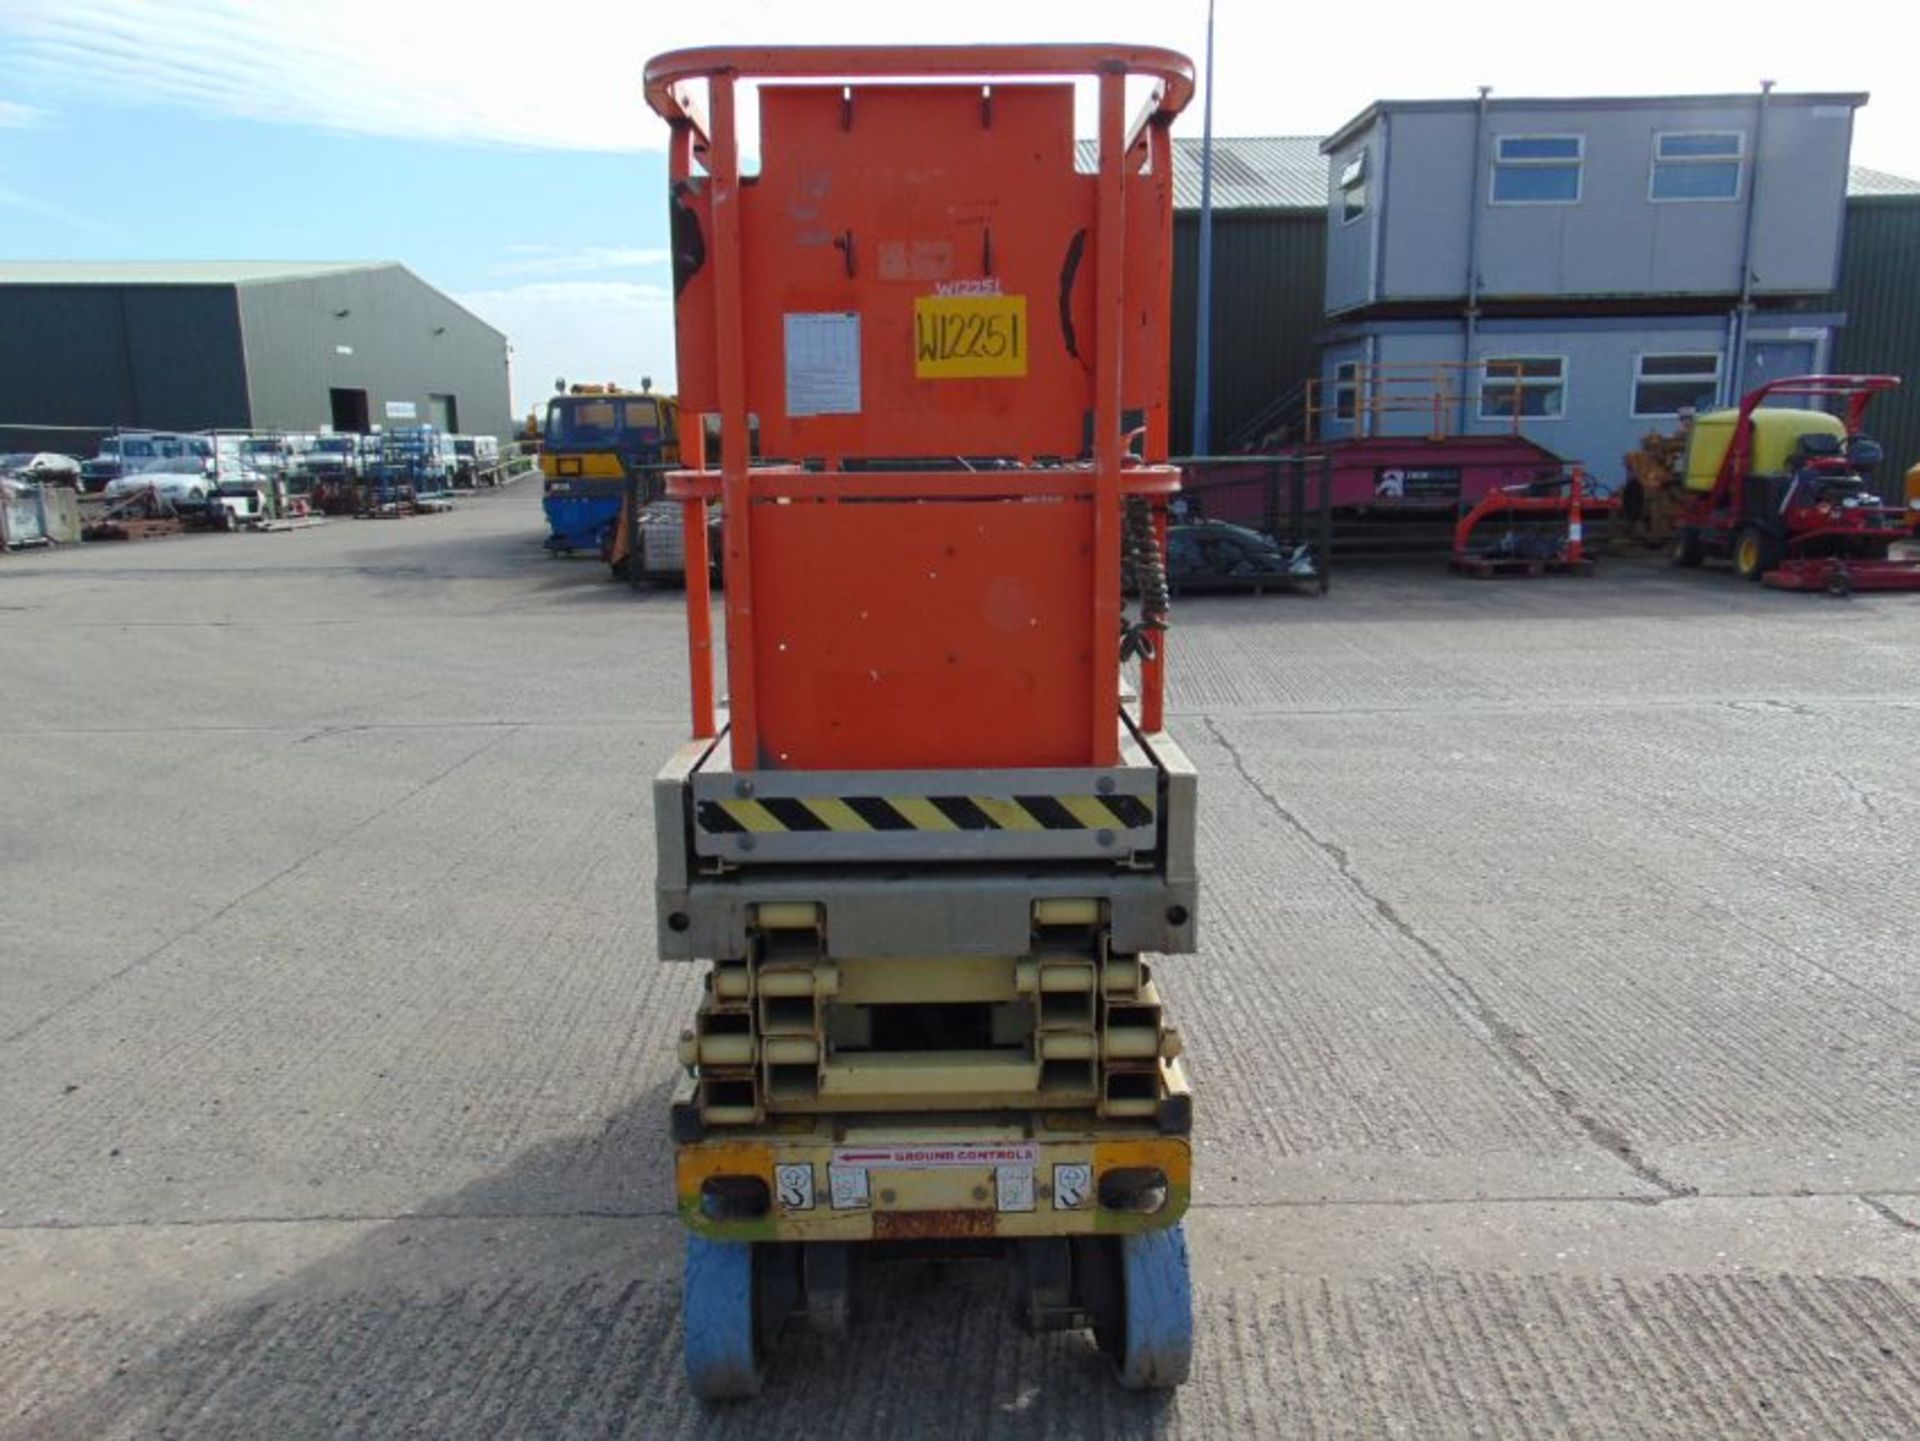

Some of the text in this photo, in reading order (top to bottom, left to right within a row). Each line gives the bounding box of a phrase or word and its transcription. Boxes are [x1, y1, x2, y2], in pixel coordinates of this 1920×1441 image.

[916, 312, 1019, 362] W12251
[894, 1150, 1034, 1163] GROUND CONTROLS
